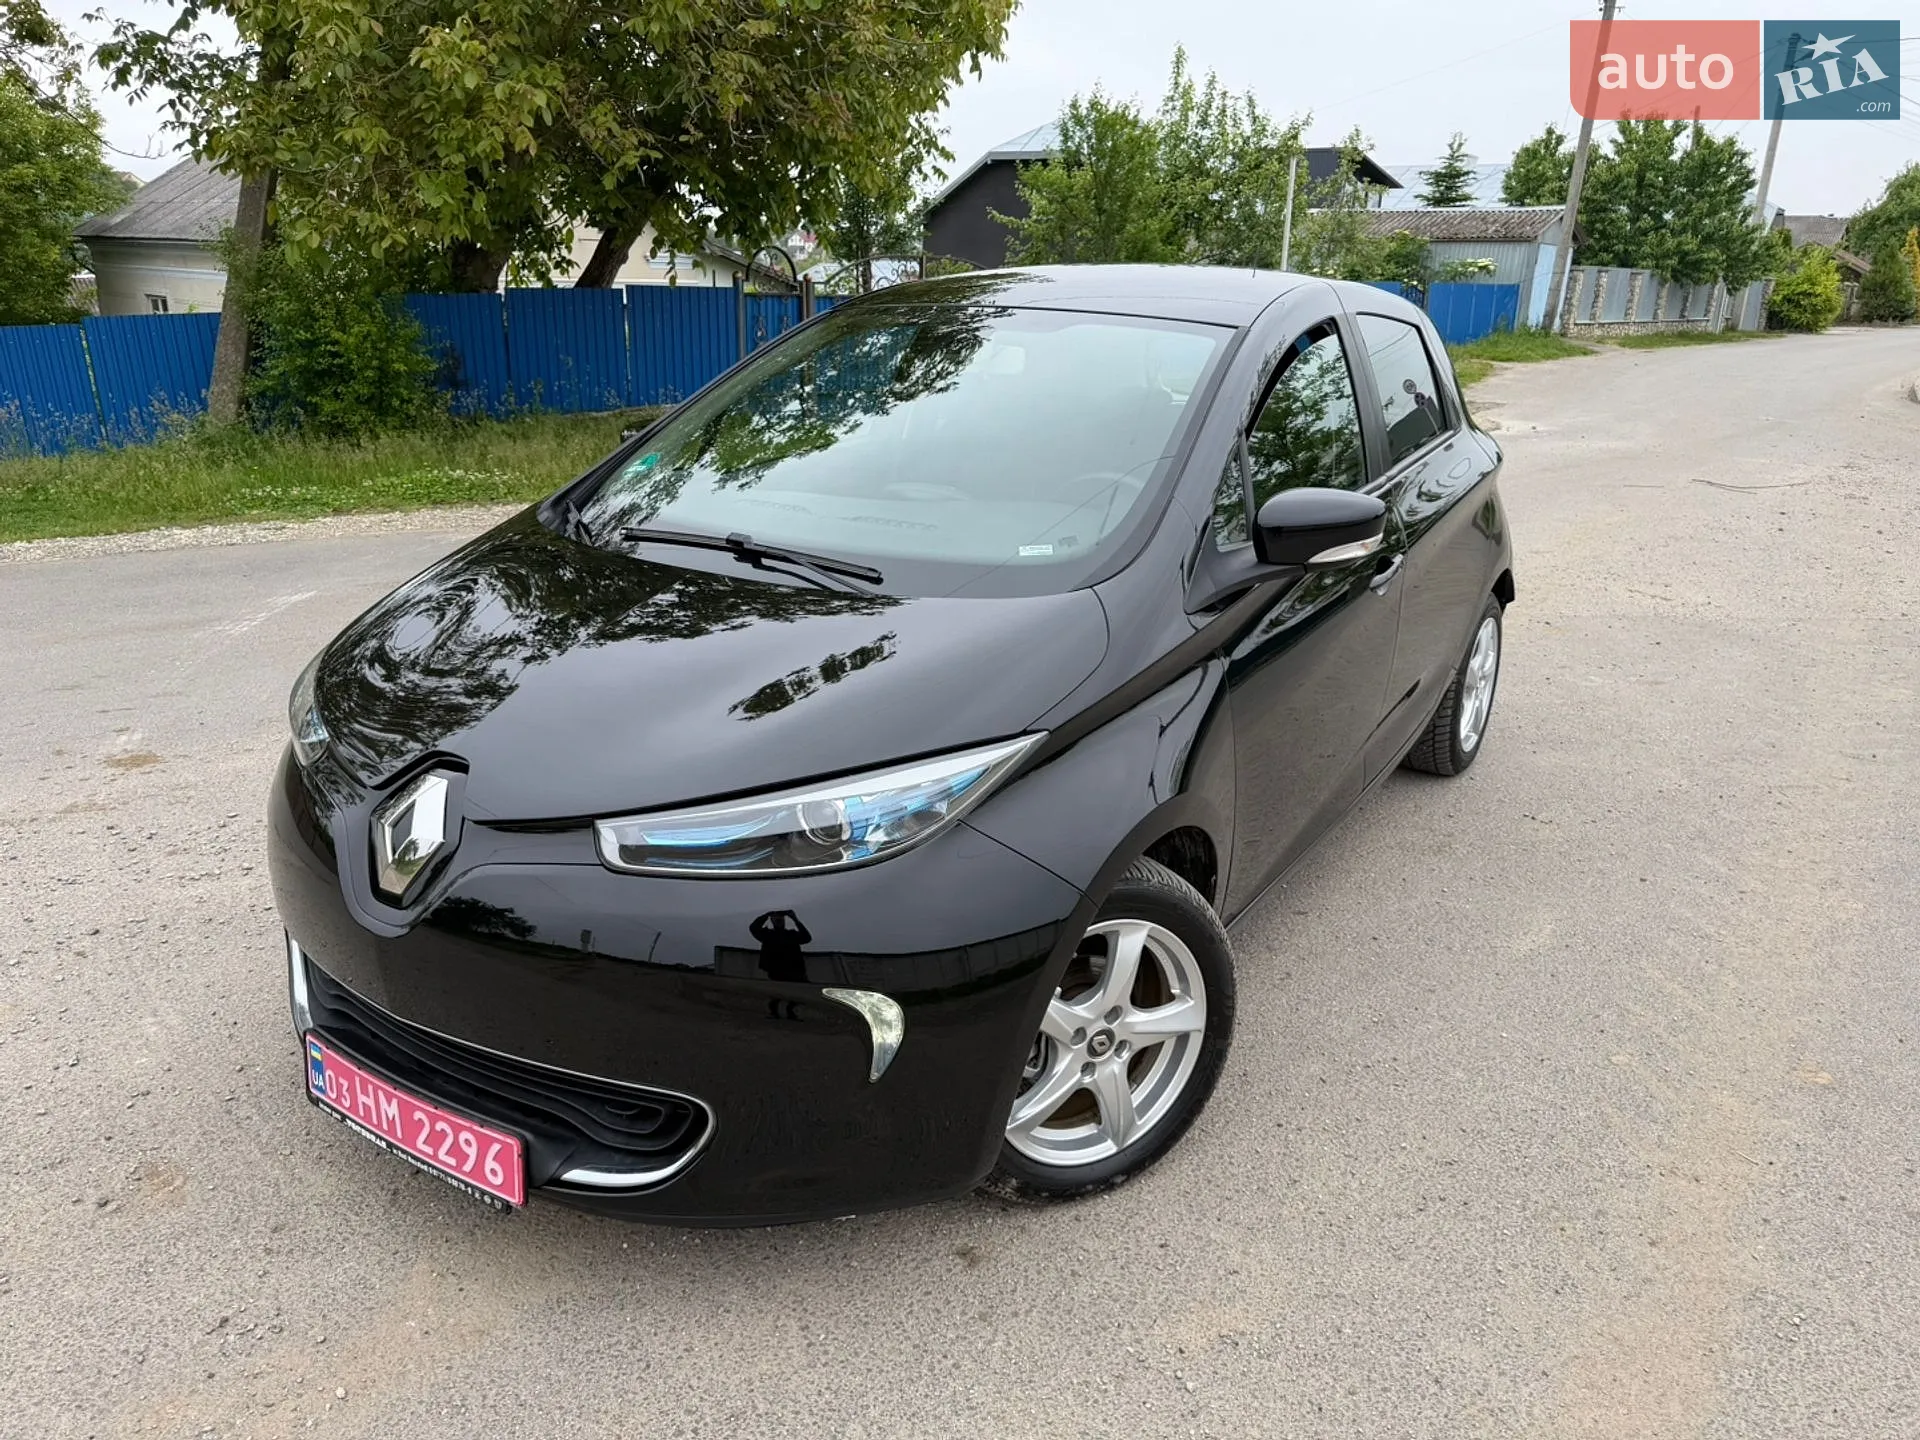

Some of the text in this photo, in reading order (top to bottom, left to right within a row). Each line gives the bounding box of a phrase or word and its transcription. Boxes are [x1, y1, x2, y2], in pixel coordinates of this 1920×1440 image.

[312, 1070, 326, 1091] UA
[325, 1068, 351, 1109] 03
[354, 1075, 403, 1140] HM
[413, 1110, 505, 1186] 2296
